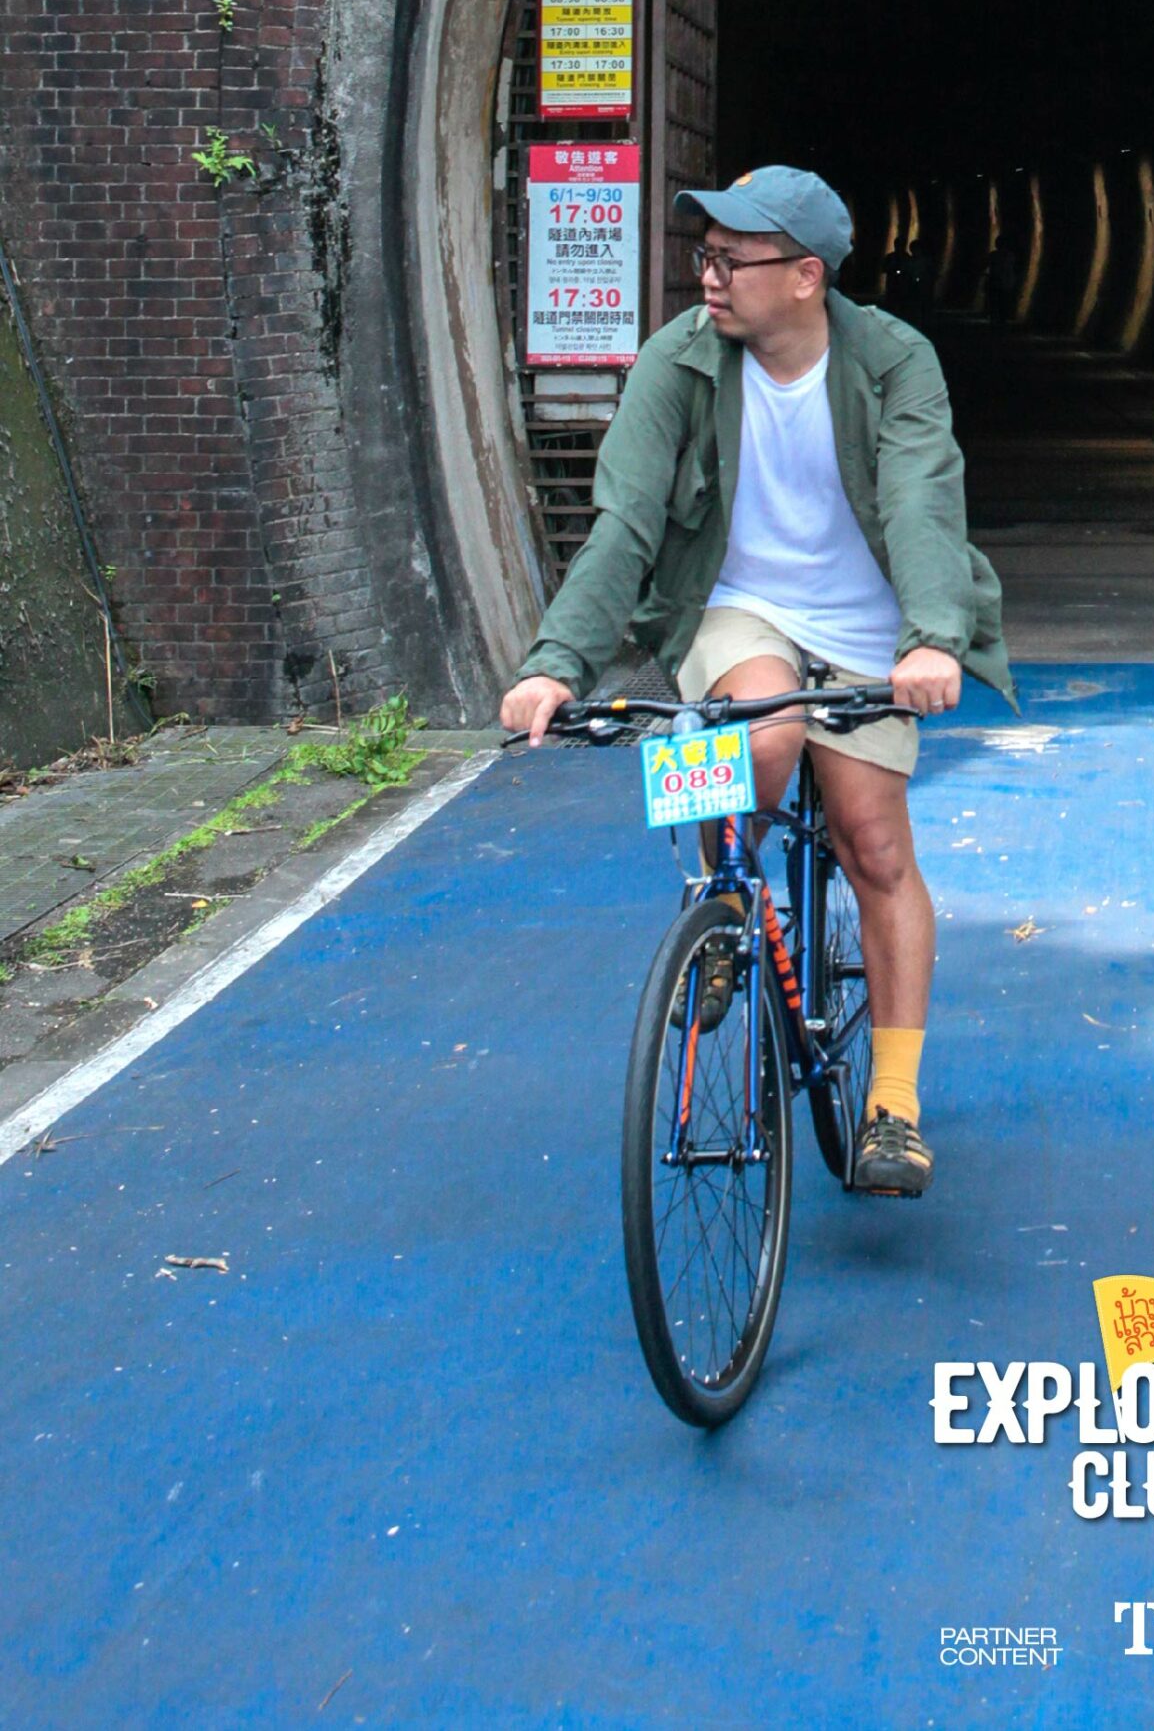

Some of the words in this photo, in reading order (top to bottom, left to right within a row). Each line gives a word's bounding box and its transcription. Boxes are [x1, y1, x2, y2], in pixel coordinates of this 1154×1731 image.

[550, 27, 580, 36] 17:00
[594, 27, 625, 36] 16:30
[551, 60, 581, 70] 17:30
[594, 60, 625, 69] 17:00
[550, 188, 623, 203] 6/1~9/30
[550, 205, 623, 224] 17:00
[555, 244, 614, 258] 請勿進入
[597, 259, 623, 267] closing
[548, 289, 621, 308] 17:30
[663, 764, 733, 793] 089
